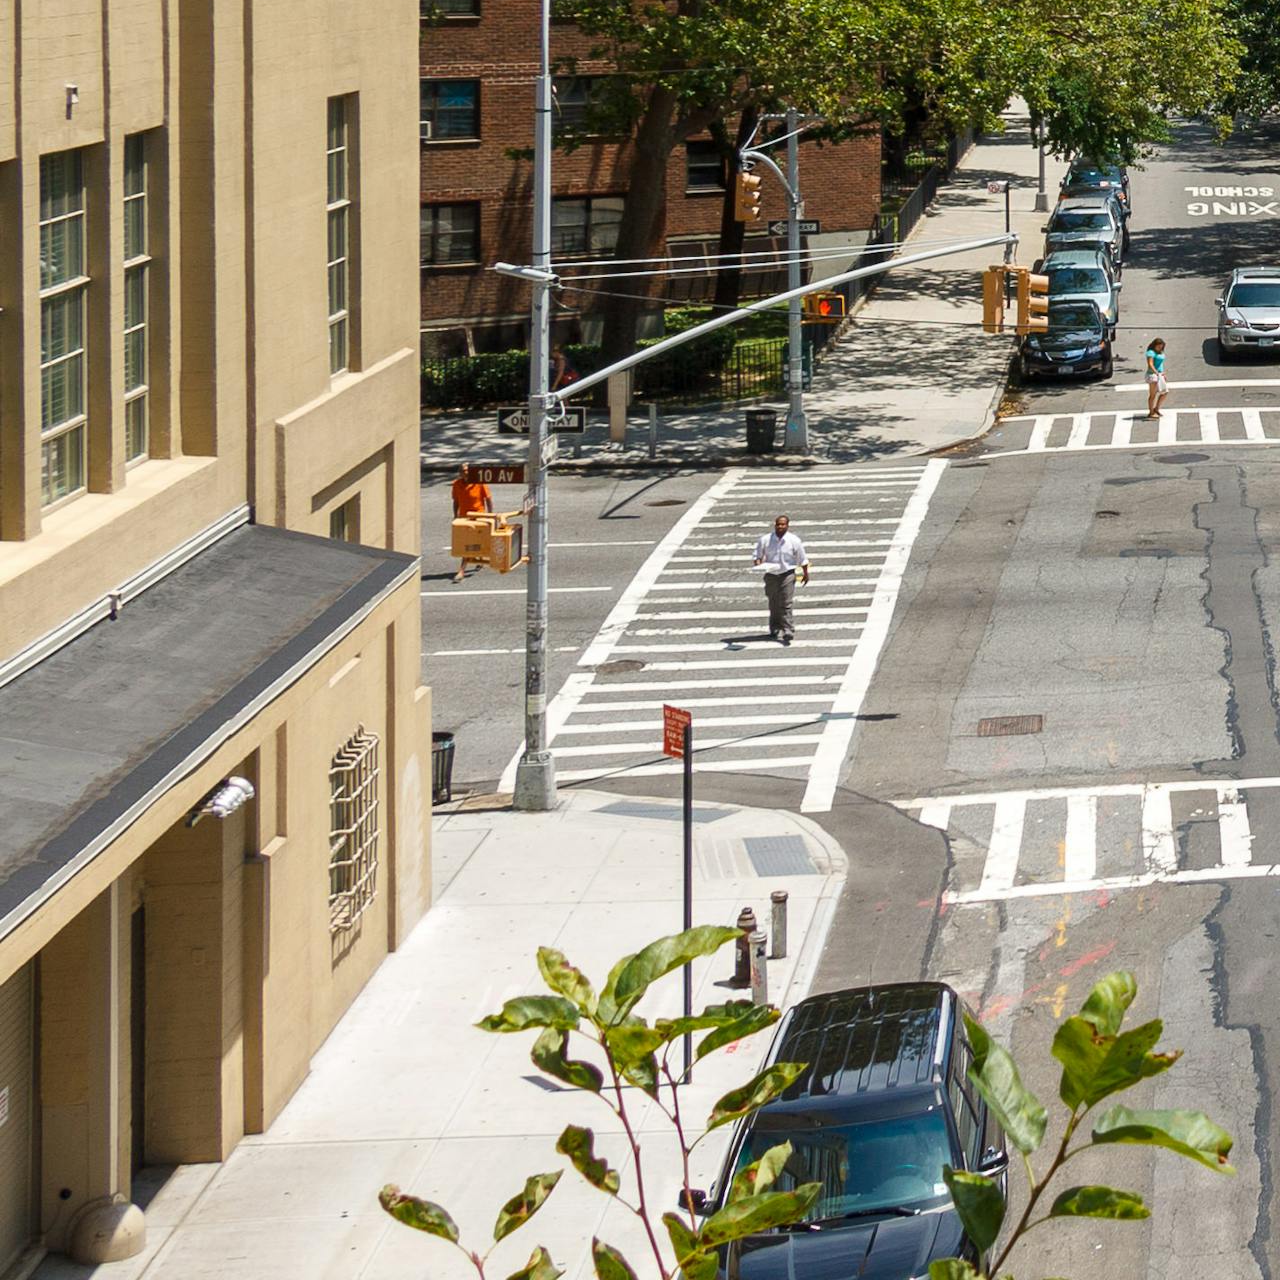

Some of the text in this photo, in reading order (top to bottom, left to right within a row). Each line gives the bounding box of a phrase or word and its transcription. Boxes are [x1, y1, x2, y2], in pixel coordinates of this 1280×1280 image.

[1184, 186, 1275, 197] SCHOOL
[477, 469, 514, 482] 10 Av
